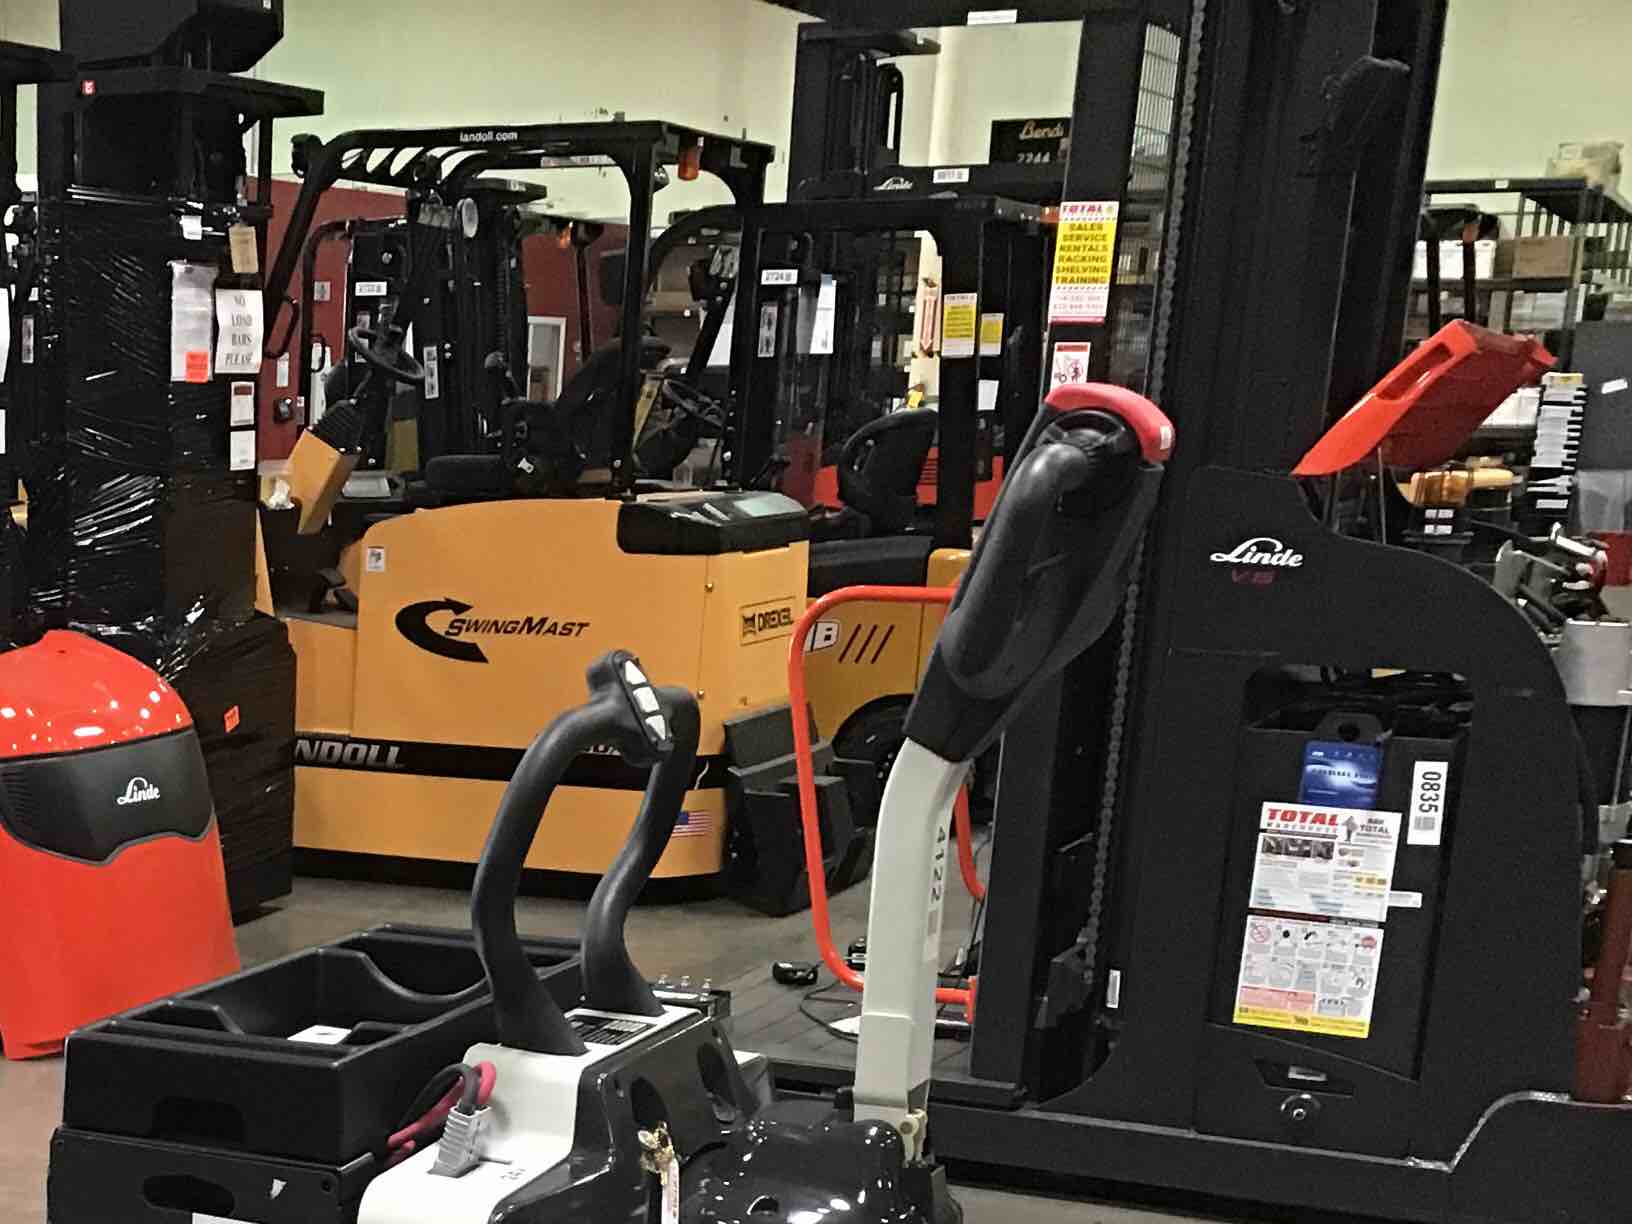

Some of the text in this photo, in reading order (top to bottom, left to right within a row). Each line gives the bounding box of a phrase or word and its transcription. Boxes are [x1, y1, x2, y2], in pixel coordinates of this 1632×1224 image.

[459, 131, 518, 143] landoll.com
[1062, 234, 1108, 242] SERVICE
[1059, 244, 1109, 252] RENTALS
[1058, 255, 1107, 263] RACKING
[1055, 276, 1107, 284] TRAINING
[231, 333, 252, 346] BARS
[1210, 537, 1303, 567] Linde
[117, 777, 160, 805] Linde
[1418, 771, 1442, 813] 0835
[1267, 808, 1339, 826] TOTAL
